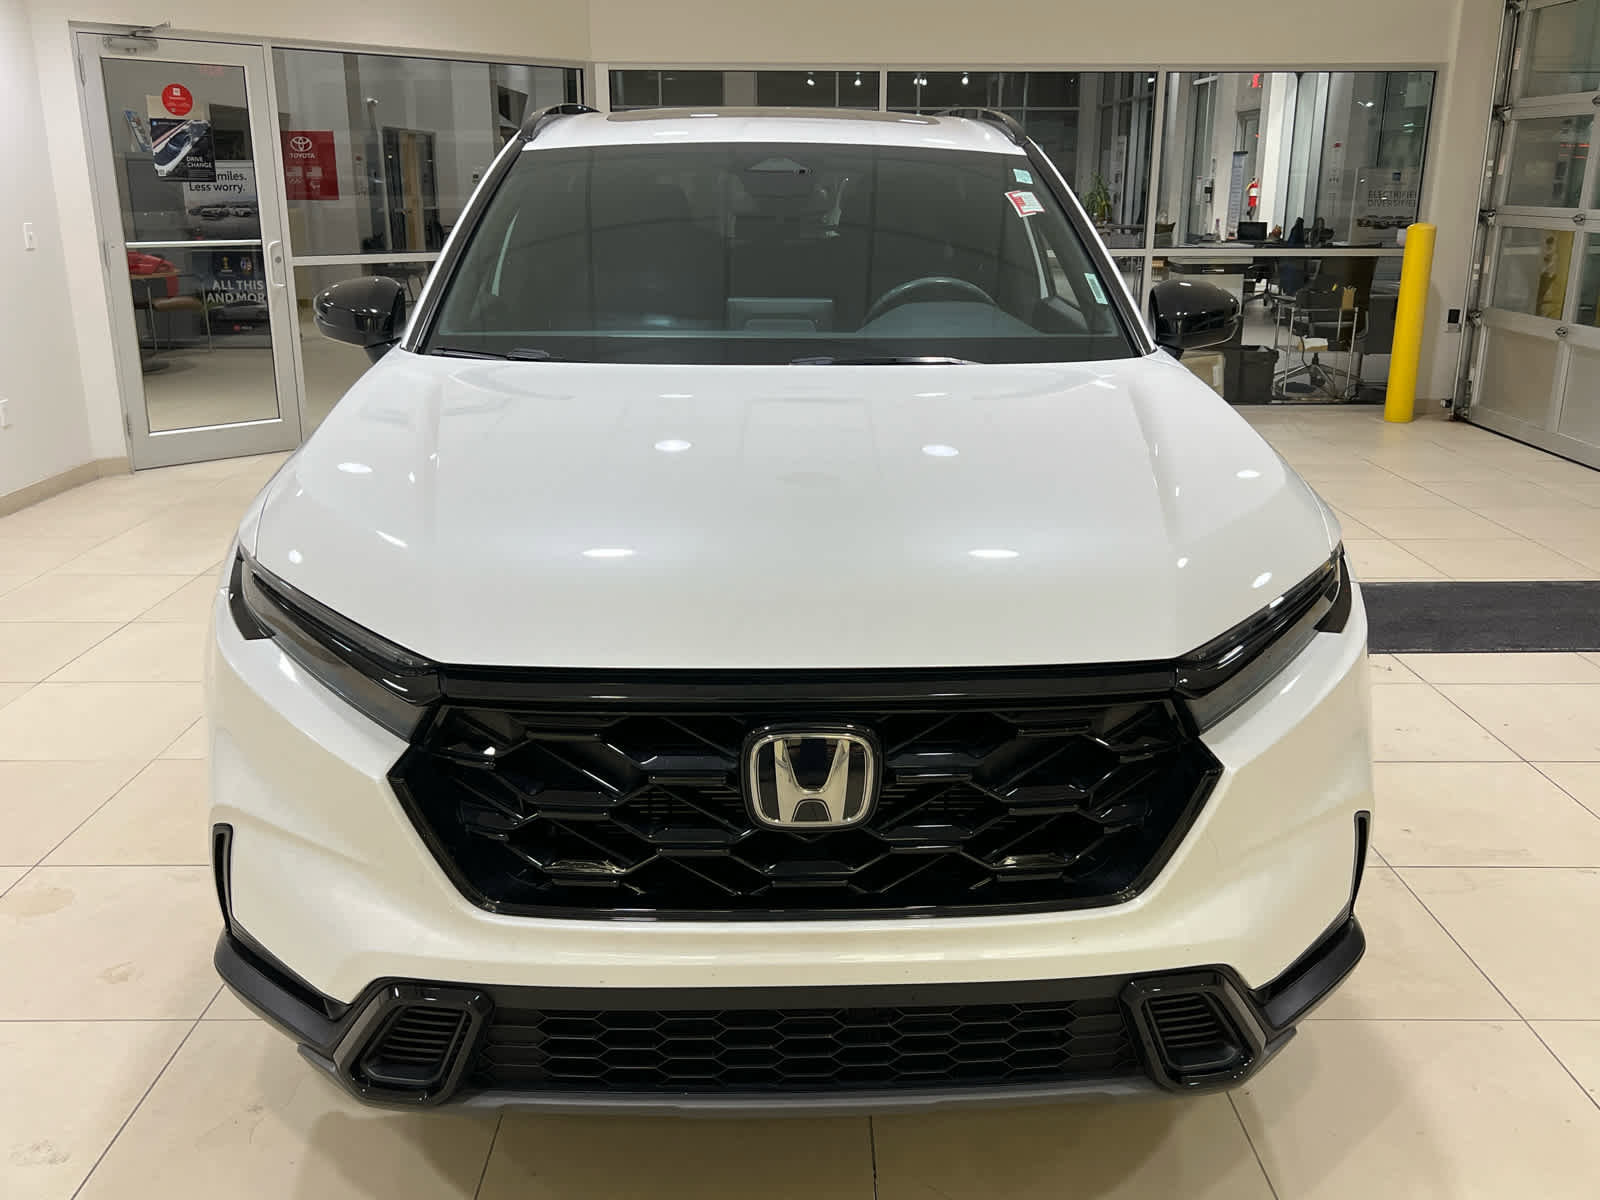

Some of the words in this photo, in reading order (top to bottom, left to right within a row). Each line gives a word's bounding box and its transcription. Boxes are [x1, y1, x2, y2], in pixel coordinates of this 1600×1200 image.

[217, 170, 247, 181] miles.
[189, 181, 211, 191] Less
[213, 184, 246, 194] worry.
[1368, 190, 1416, 199] ELECTRIFIE
[212, 280, 234, 290] ALL
[236, 280, 264, 290] THIS
[207, 292, 234, 304] AND
[236, 292, 265, 303] MOR
